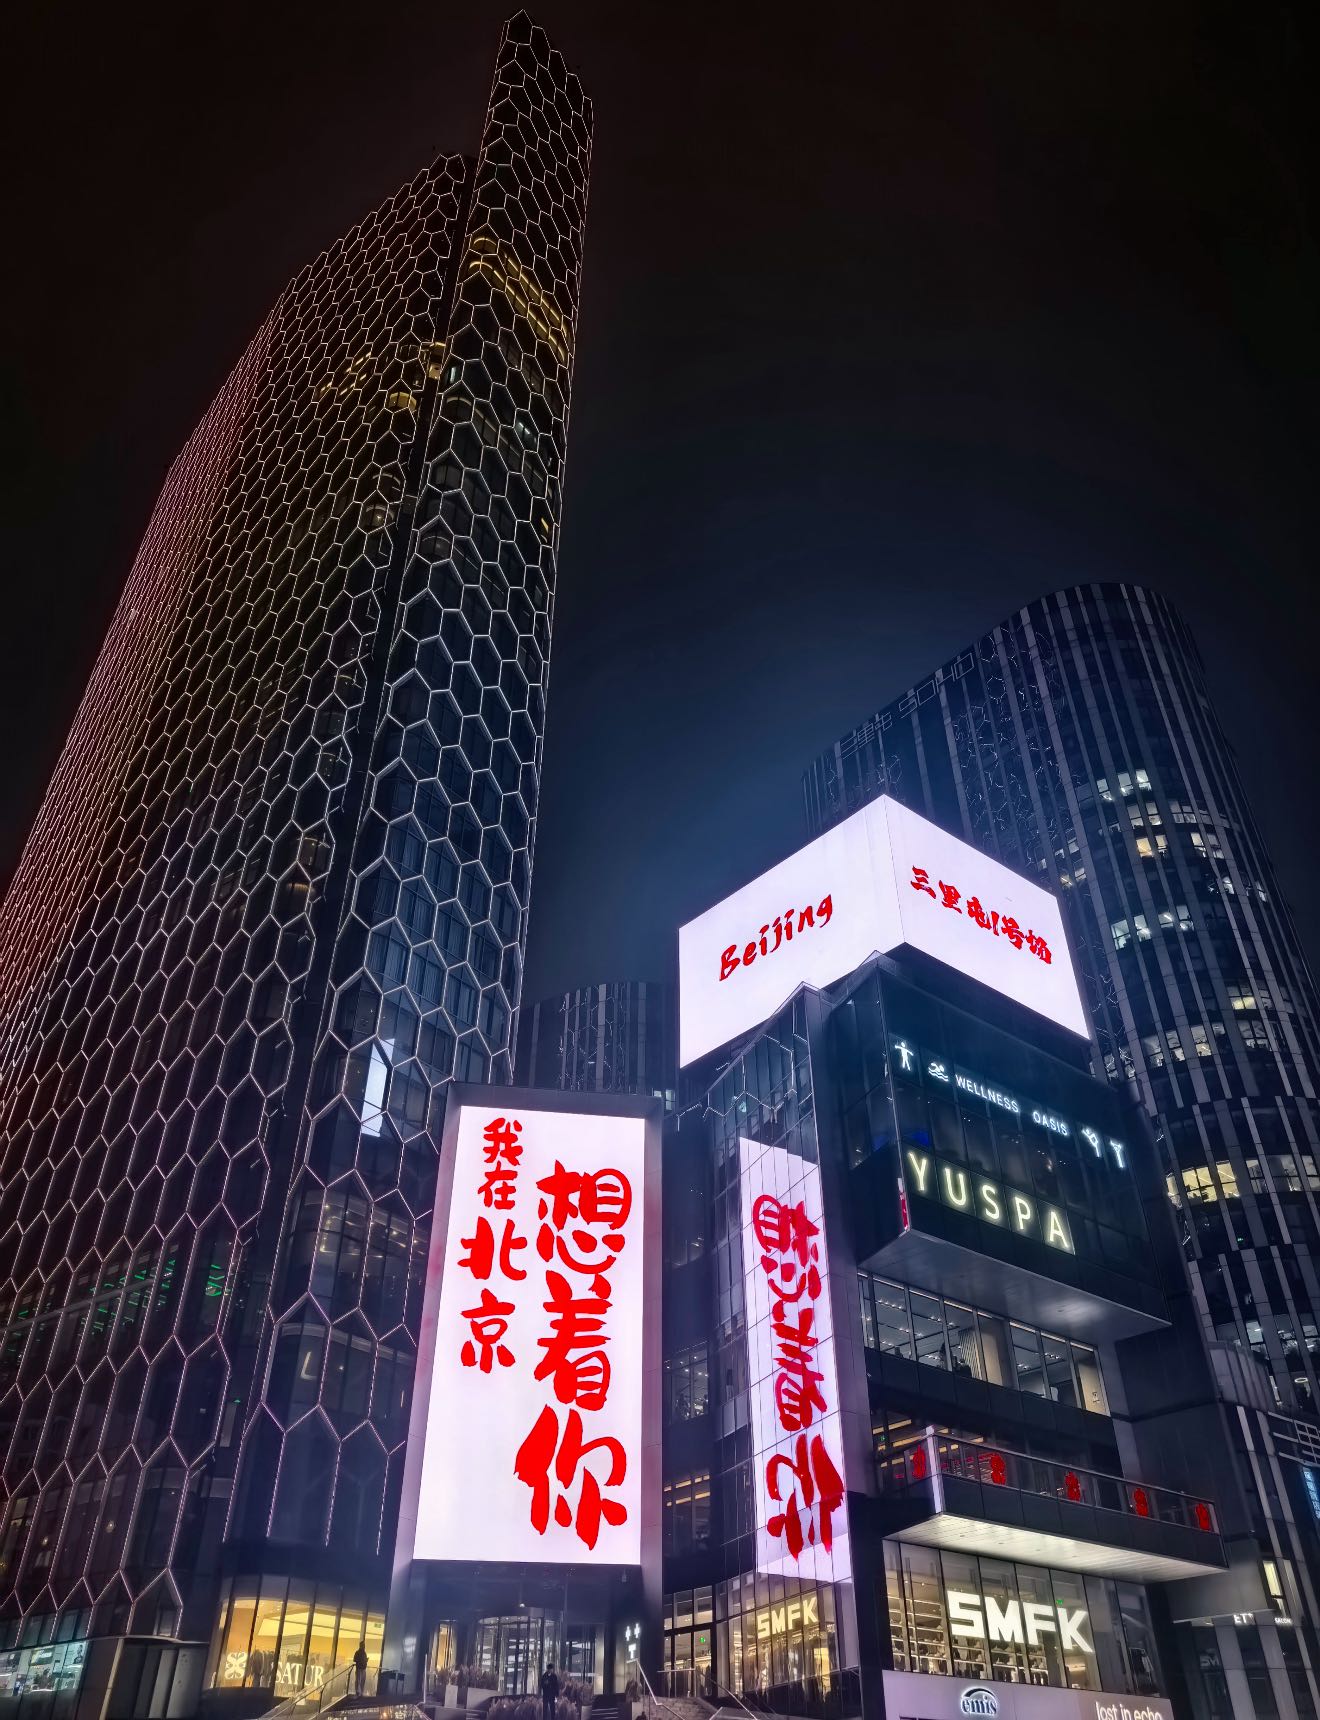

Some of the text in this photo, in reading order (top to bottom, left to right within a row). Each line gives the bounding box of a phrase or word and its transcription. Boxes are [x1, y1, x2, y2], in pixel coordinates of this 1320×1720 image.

[898, 652, 975, 719] SOHO
[719, 894, 833, 981] Beijing
[955, 1073, 1070, 1136] WELLNESS OASIS
[457, 1117, 528, 1373] 我在北京
[514, 1159, 632, 1550] 想着你
[757, 1596, 819, 1639] SMFK
[947, 1590, 1095, 1653] SMFK
[961, 1695, 998, 1715] emis
[1095, 1701, 1164, 1720] lost in echo
